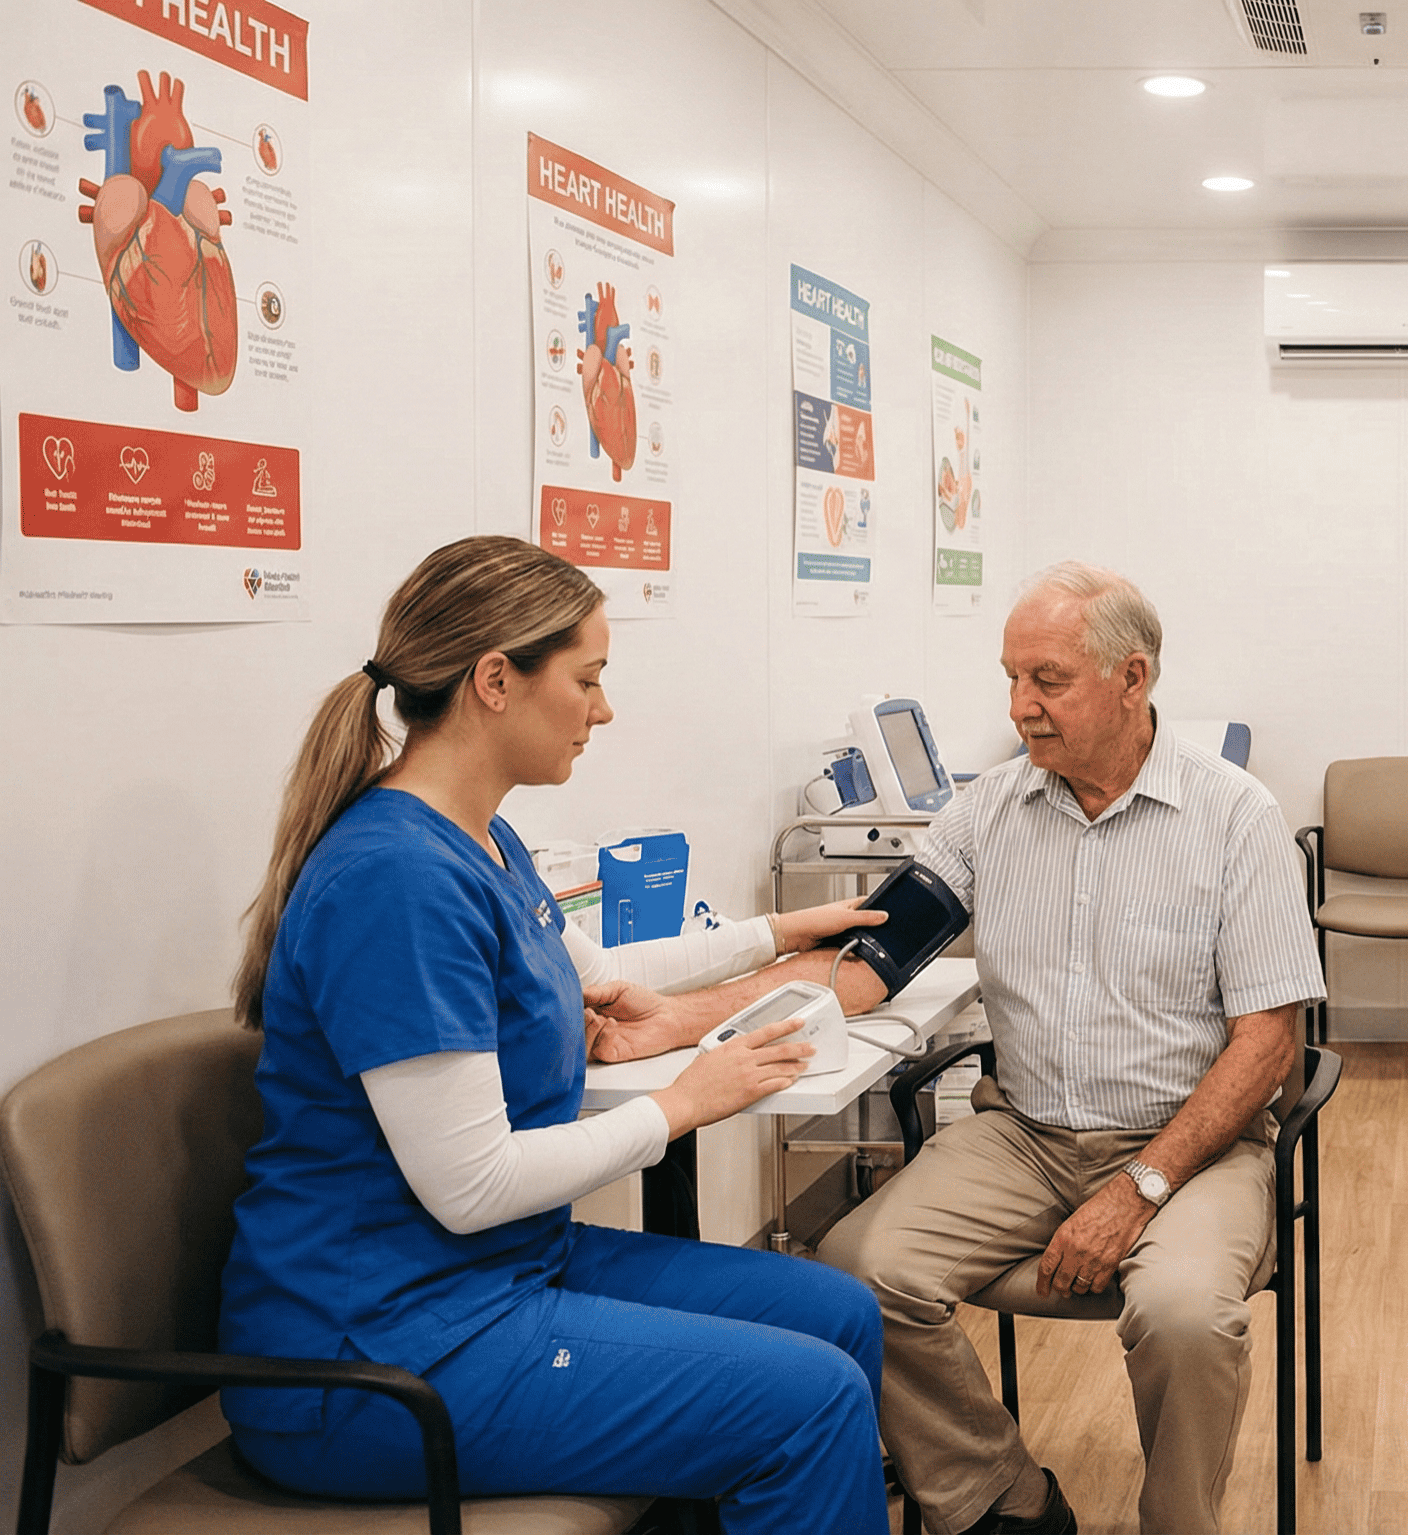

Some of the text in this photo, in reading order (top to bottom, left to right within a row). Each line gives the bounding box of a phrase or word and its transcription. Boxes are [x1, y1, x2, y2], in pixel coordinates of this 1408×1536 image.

[540, 155, 665, 240] HEART HEALTH
[797, 279, 832, 314] HEART
